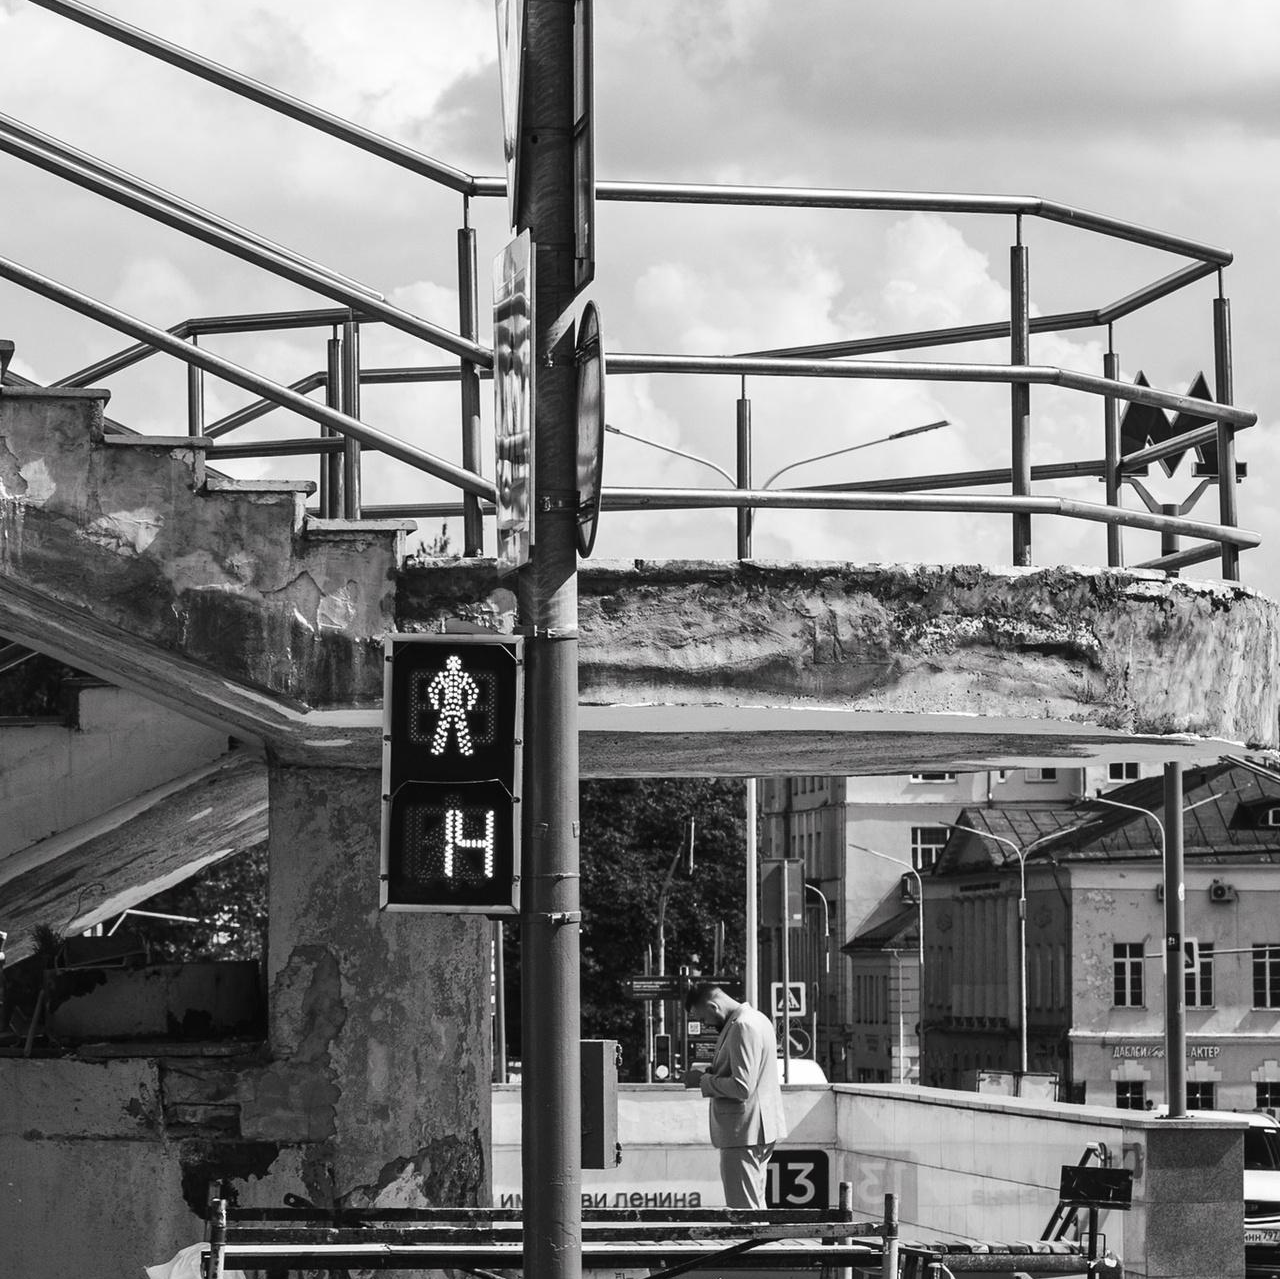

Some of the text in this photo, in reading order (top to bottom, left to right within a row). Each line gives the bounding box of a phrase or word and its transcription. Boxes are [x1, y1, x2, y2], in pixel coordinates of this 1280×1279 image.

[1113, 1046, 1147, 1058] ДАБЛБИ
[767, 1162, 816, 1204] 13
[613, 1192, 701, 1208] ленина
